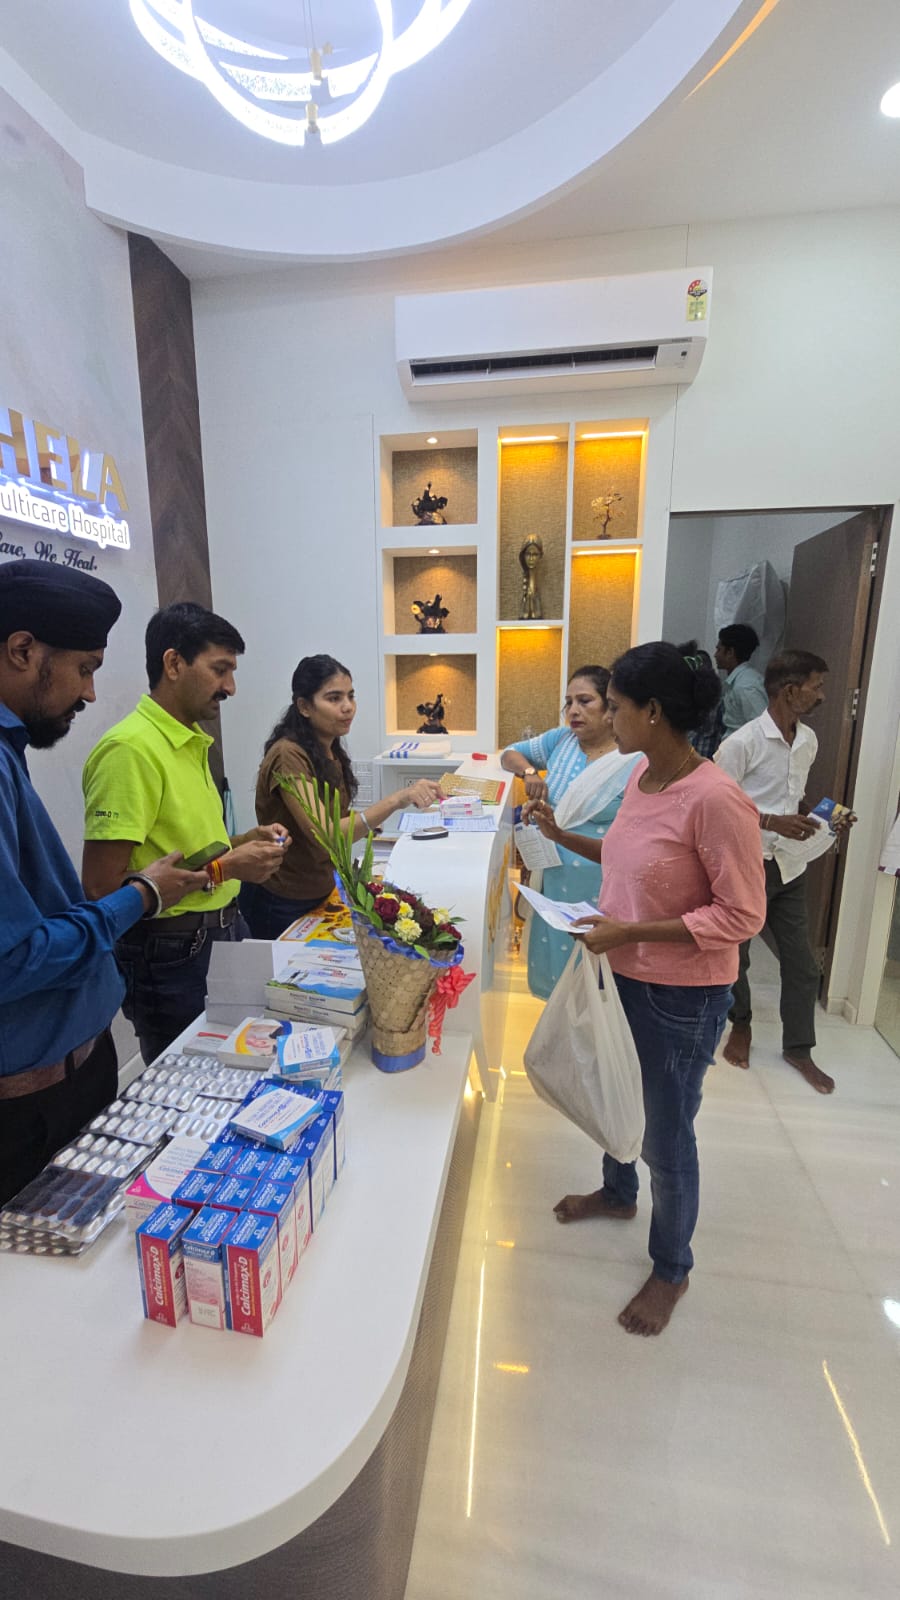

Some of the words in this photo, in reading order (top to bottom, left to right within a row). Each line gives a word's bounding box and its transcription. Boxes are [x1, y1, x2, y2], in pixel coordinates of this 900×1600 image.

[71, 509, 129, 545] Hospital
[0, 532, 26, 559] are,
[34, 540, 57, 563] We
